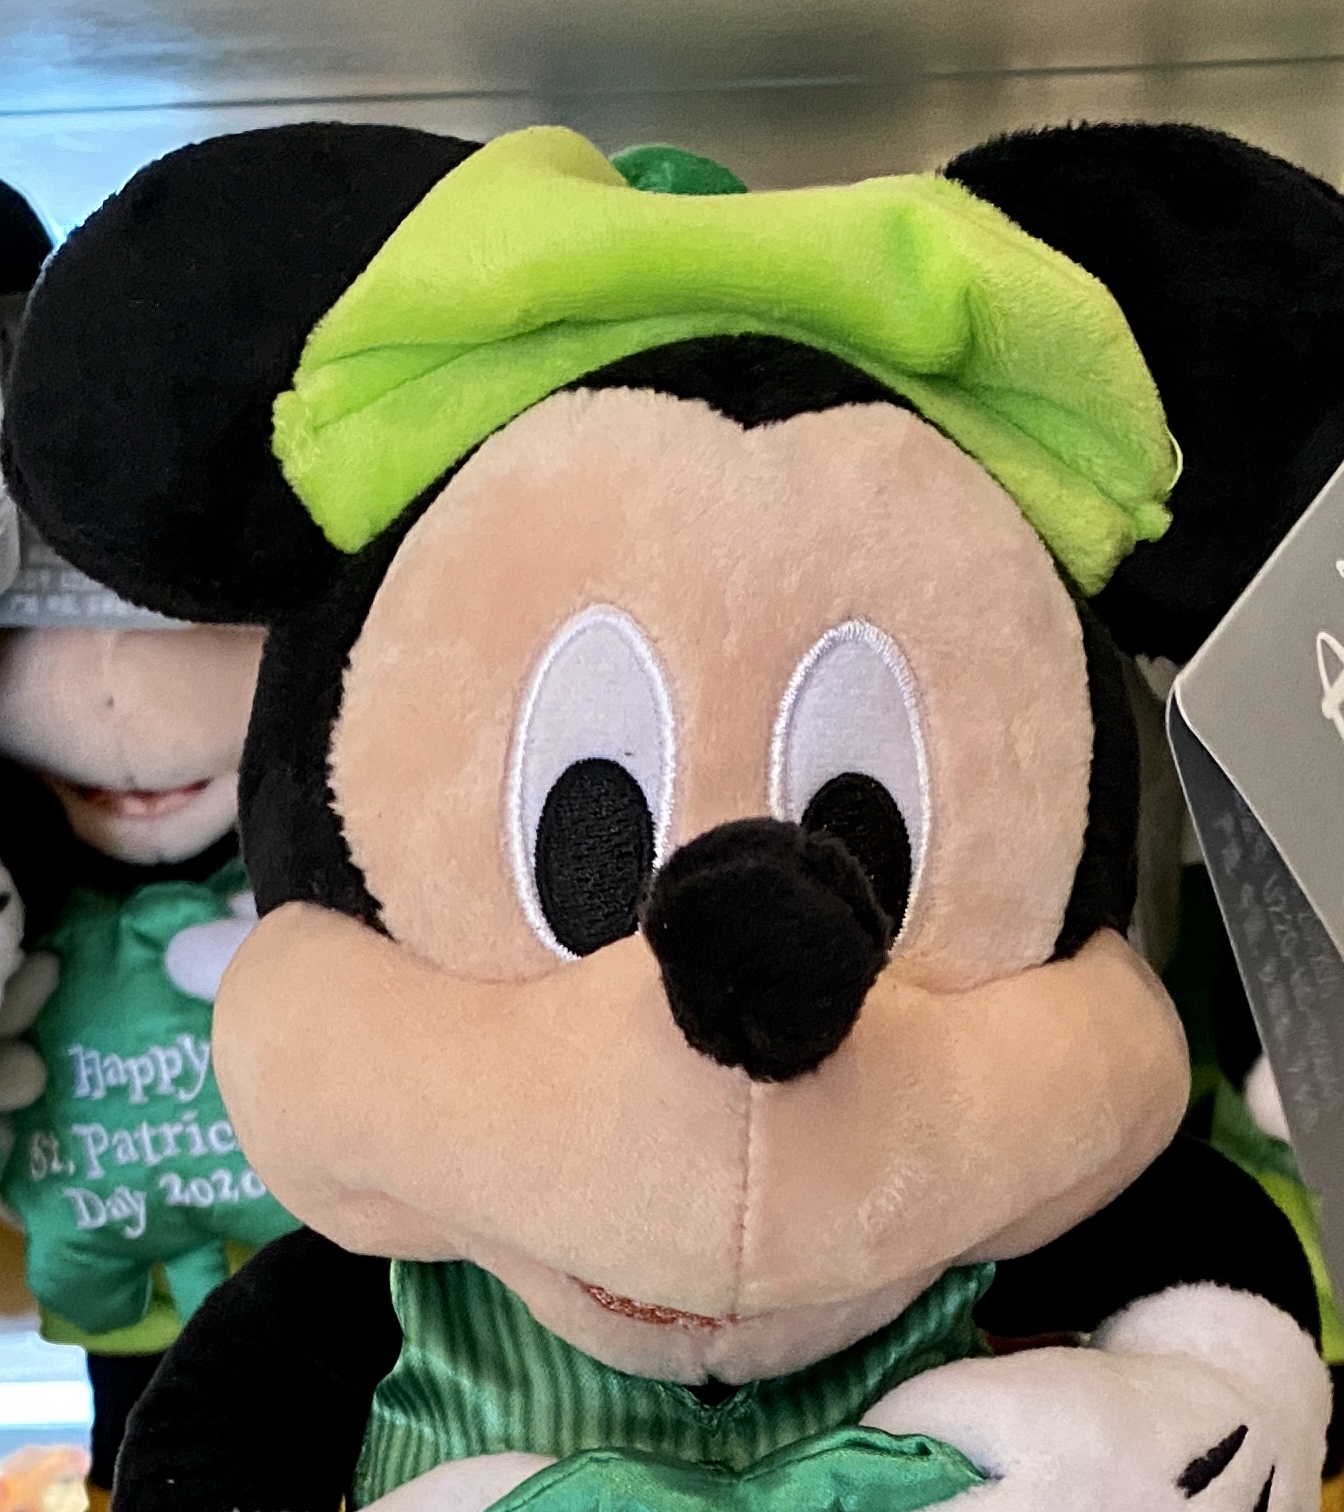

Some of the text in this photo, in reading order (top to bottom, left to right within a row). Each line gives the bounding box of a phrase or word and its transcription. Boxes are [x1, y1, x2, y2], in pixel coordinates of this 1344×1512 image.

[68, 1032, 211, 1104] Happy
[63, 1168, 267, 1239] Day 2020
